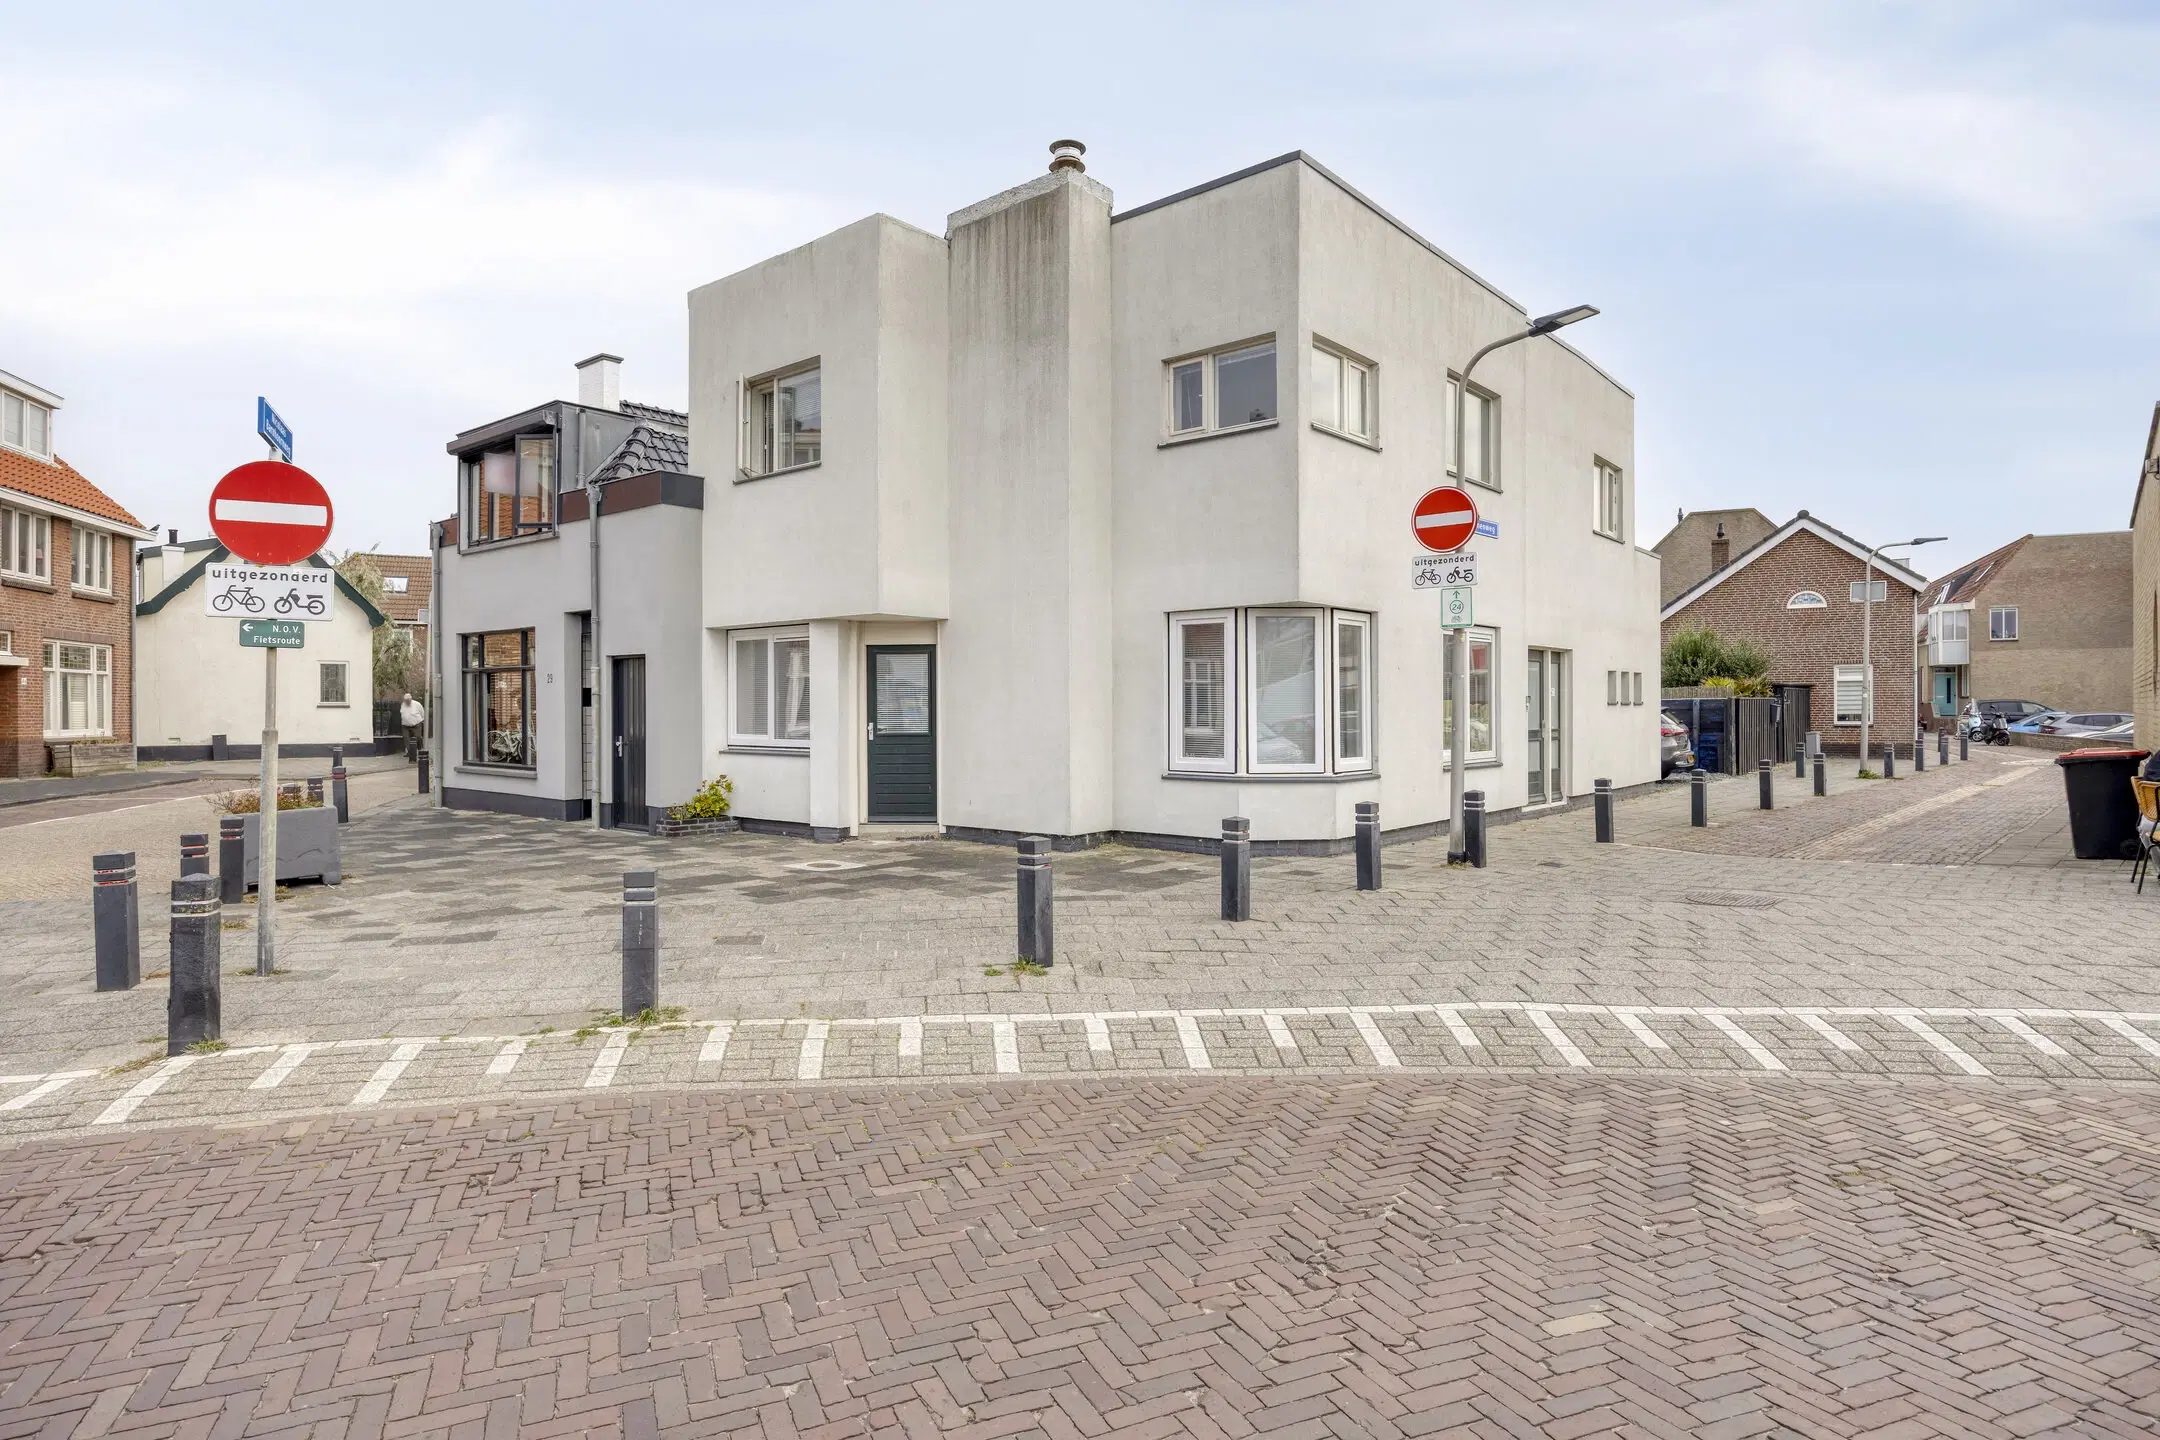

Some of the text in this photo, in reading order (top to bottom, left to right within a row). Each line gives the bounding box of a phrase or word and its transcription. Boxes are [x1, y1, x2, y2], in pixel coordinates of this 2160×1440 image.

[1415, 555, 1475, 566] uitgezonderd
[212, 568, 328, 583] uitgezonderd
[272, 625, 301, 634] N.O.V.
[253, 635, 301, 645] Fietsroute
